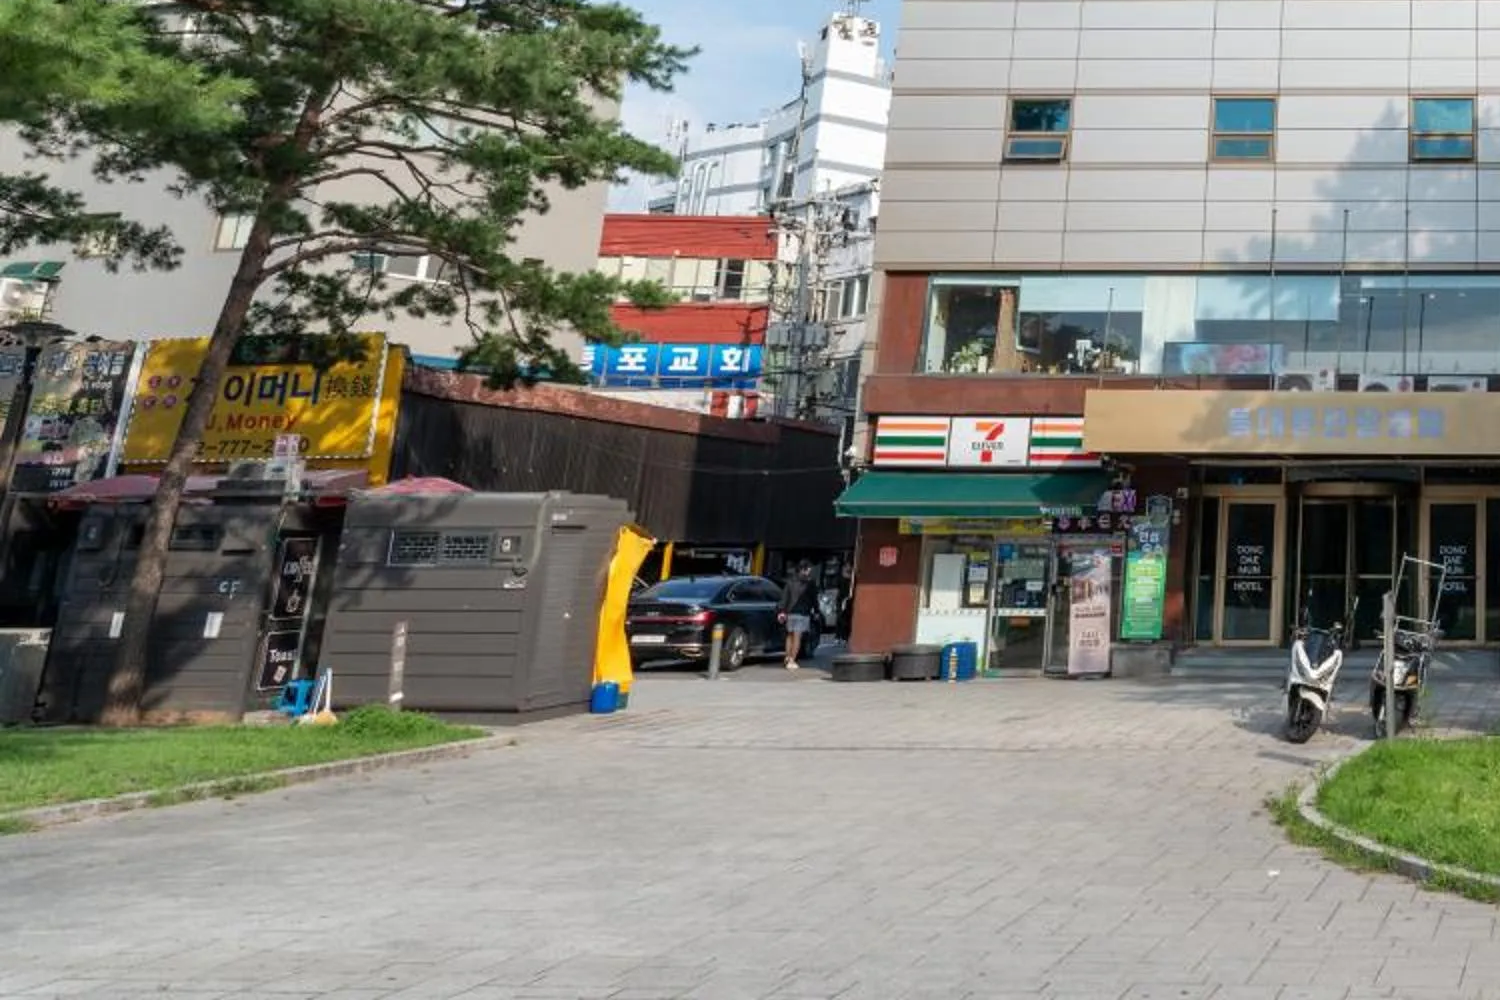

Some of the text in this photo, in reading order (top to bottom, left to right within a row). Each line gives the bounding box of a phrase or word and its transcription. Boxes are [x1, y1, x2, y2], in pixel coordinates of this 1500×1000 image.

[185, 372, 320, 405] 이머니
[1237, 545, 1264, 555] DONG
[1440, 545, 1467, 555] DONG
[1239, 555, 1261, 565] DAE
[1443, 555, 1464, 565] DAE
[1239, 565, 1261, 575] MUN
[1233, 580, 1263, 591] HOTEL
